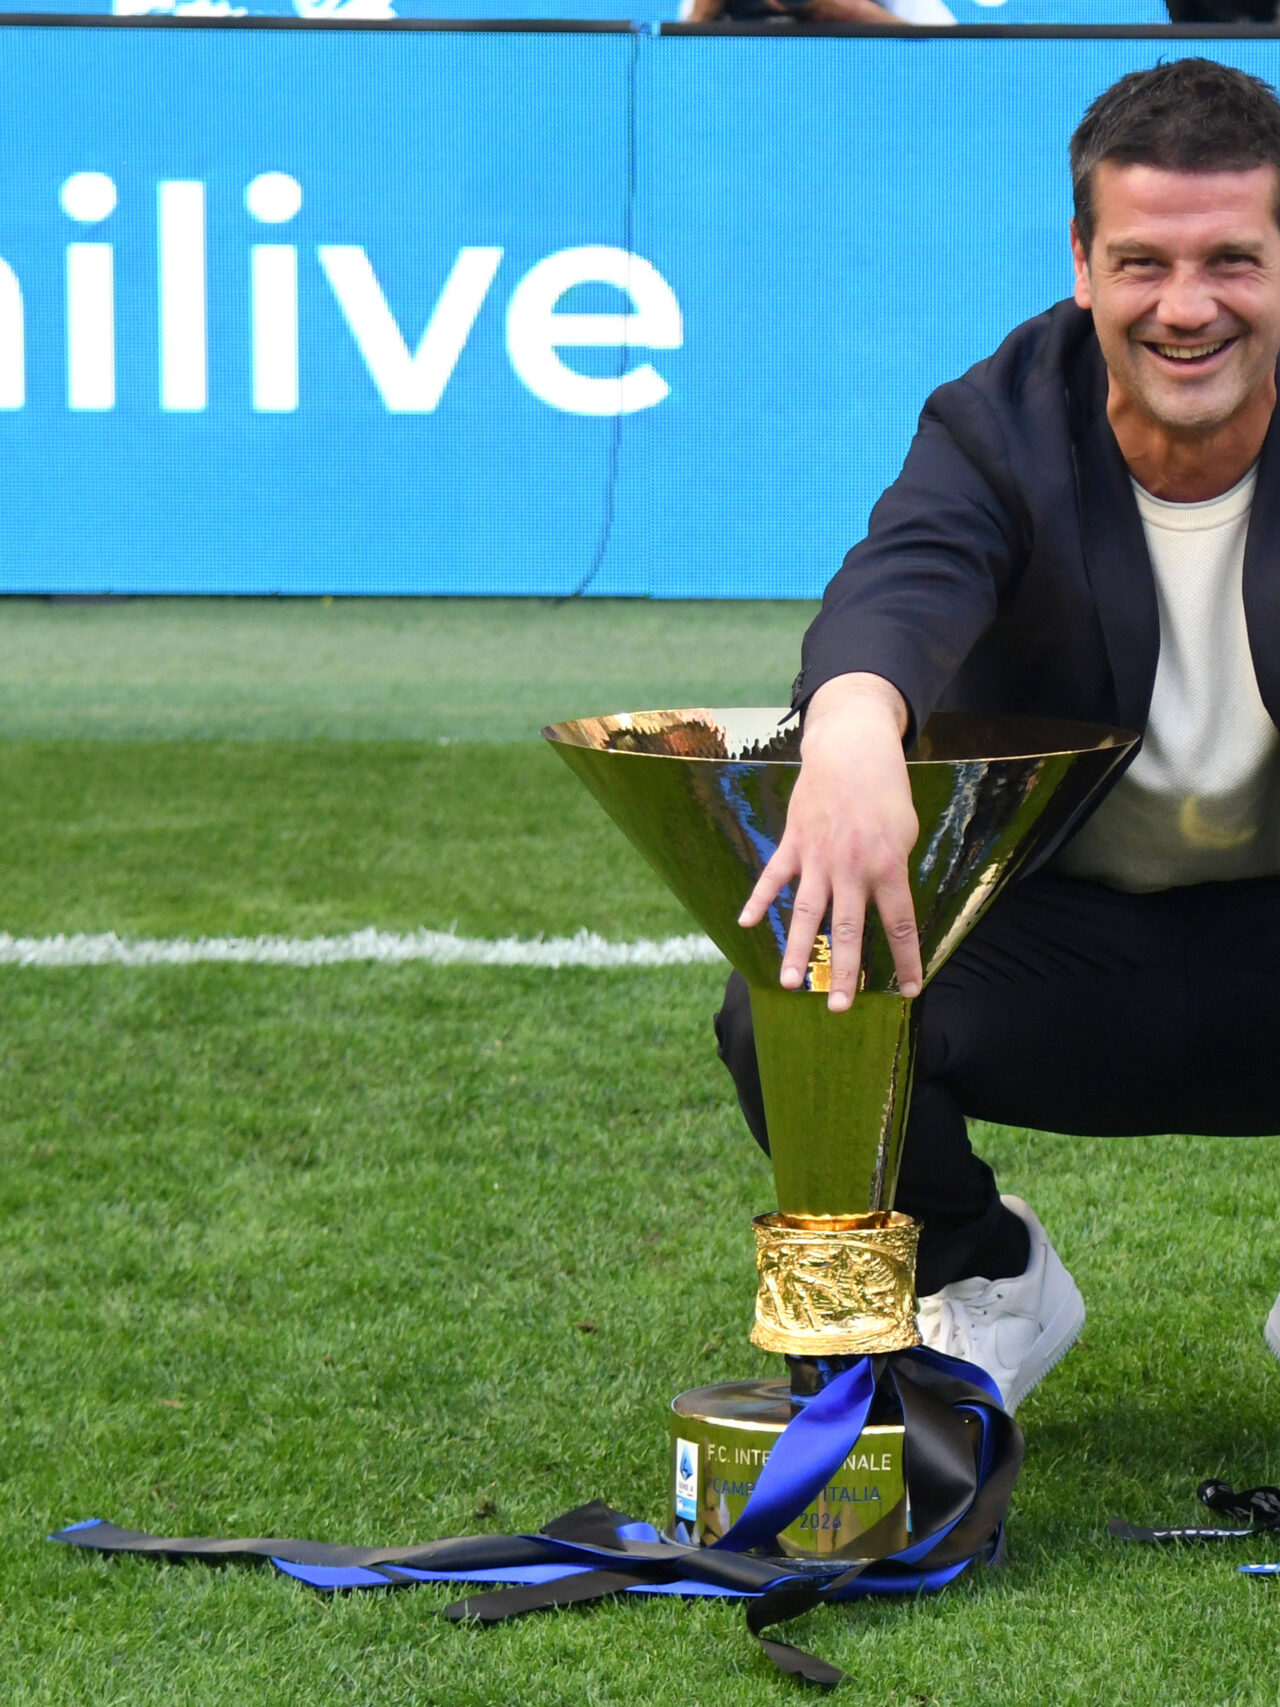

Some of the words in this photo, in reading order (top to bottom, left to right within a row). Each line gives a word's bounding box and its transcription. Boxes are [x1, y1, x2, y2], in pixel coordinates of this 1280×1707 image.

[0, 171, 684, 416] ilive
[707, 1443, 731, 1463] F.C.
[800, 1512, 842, 1531] 2026
